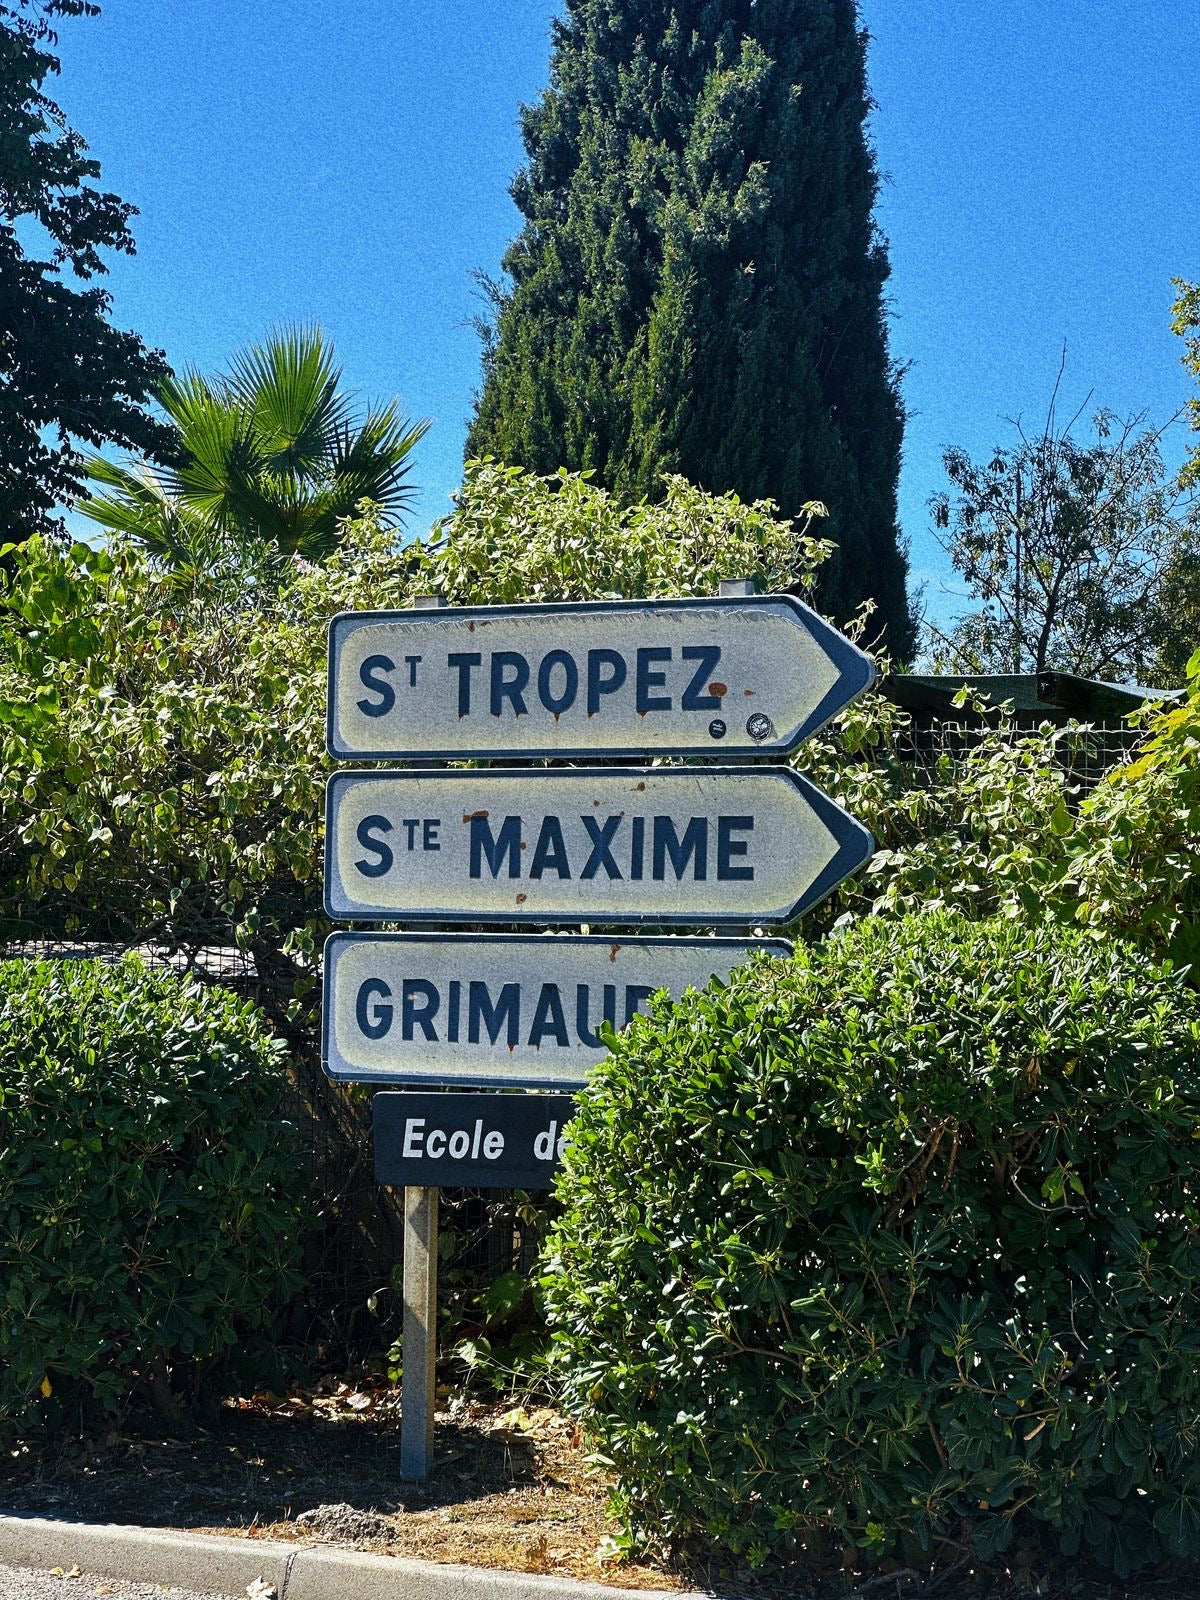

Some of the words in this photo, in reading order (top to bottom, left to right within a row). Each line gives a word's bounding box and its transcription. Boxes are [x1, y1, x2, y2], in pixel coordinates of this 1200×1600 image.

[448, 645, 722, 717] TROPEZ
[468, 815, 755, 881] MAXIME
[402, 1118, 505, 1160] Ecole
